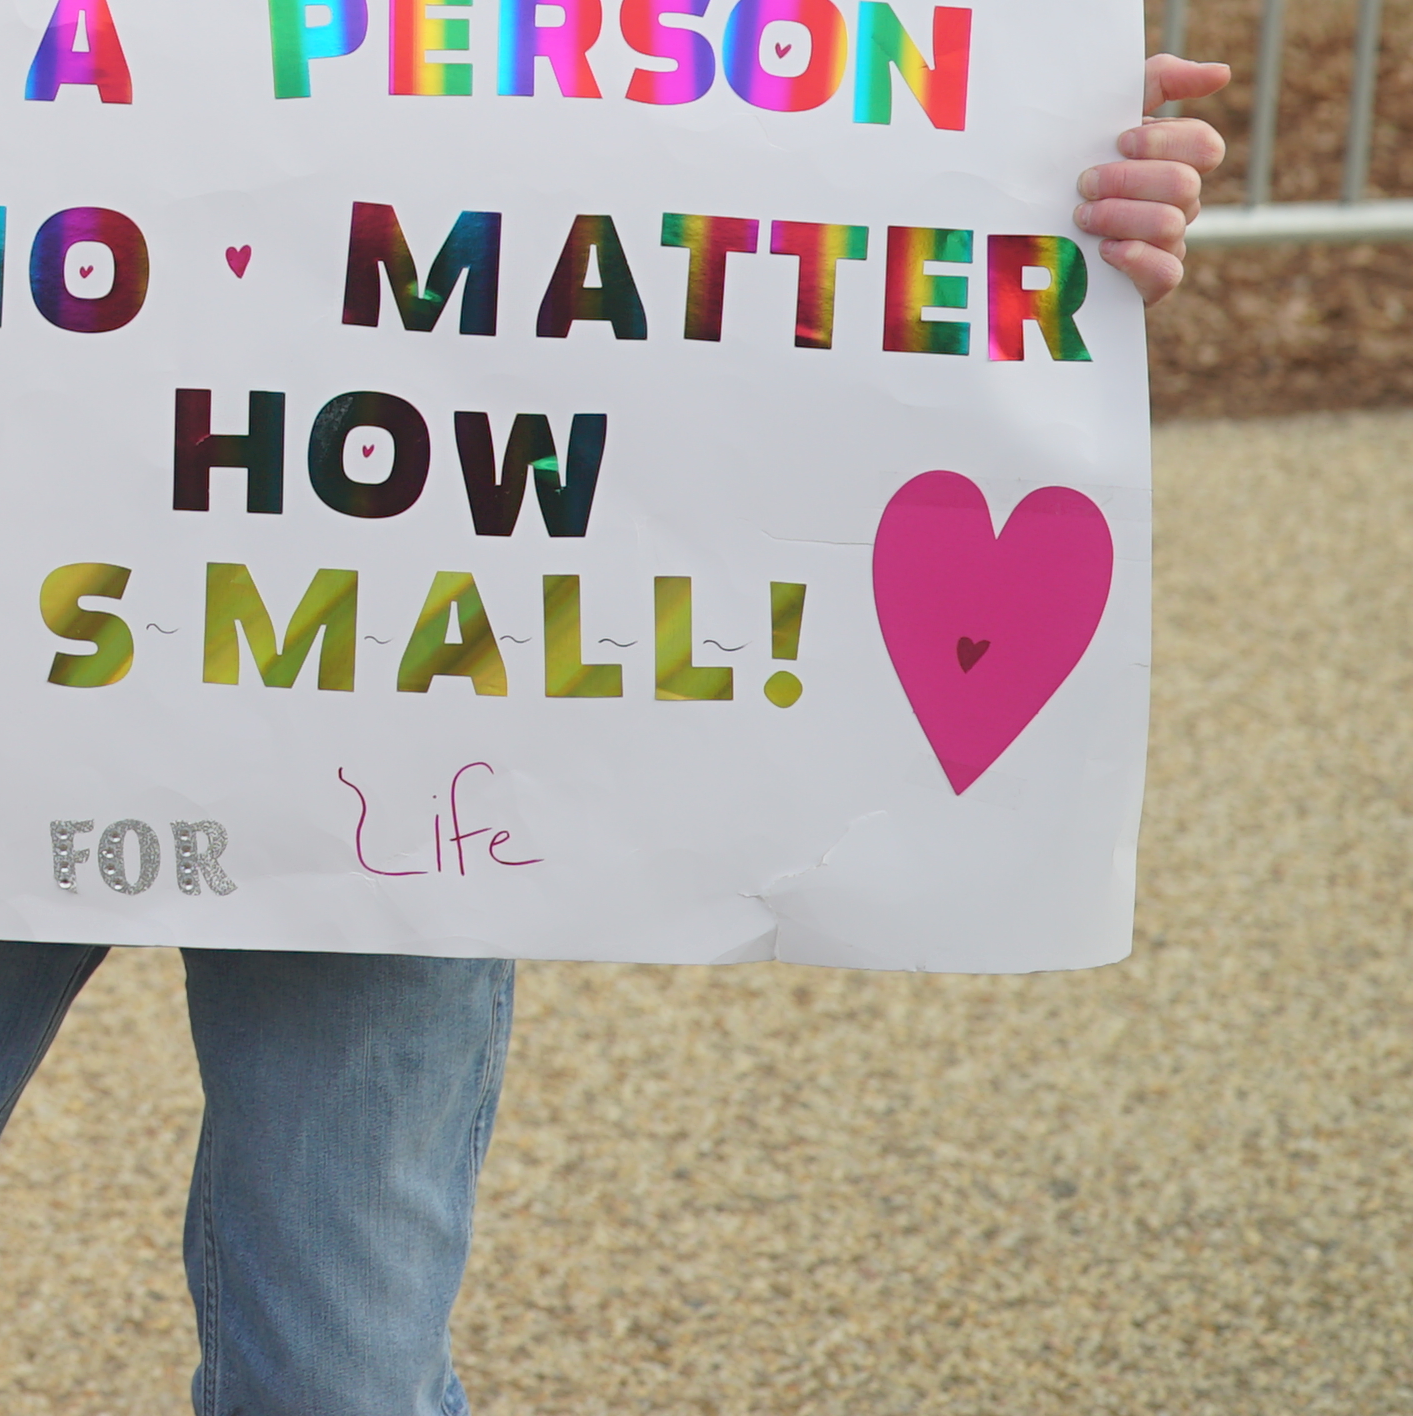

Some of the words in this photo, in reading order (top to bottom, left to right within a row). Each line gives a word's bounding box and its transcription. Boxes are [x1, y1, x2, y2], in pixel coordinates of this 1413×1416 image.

[342, 201, 1093, 362] MATTER
[173, 388, 607, 537] HOW
[39, 562, 807, 708] SMALL!
[49, 818, 238, 896] FOR
[339, 763, 544, 878] Life
